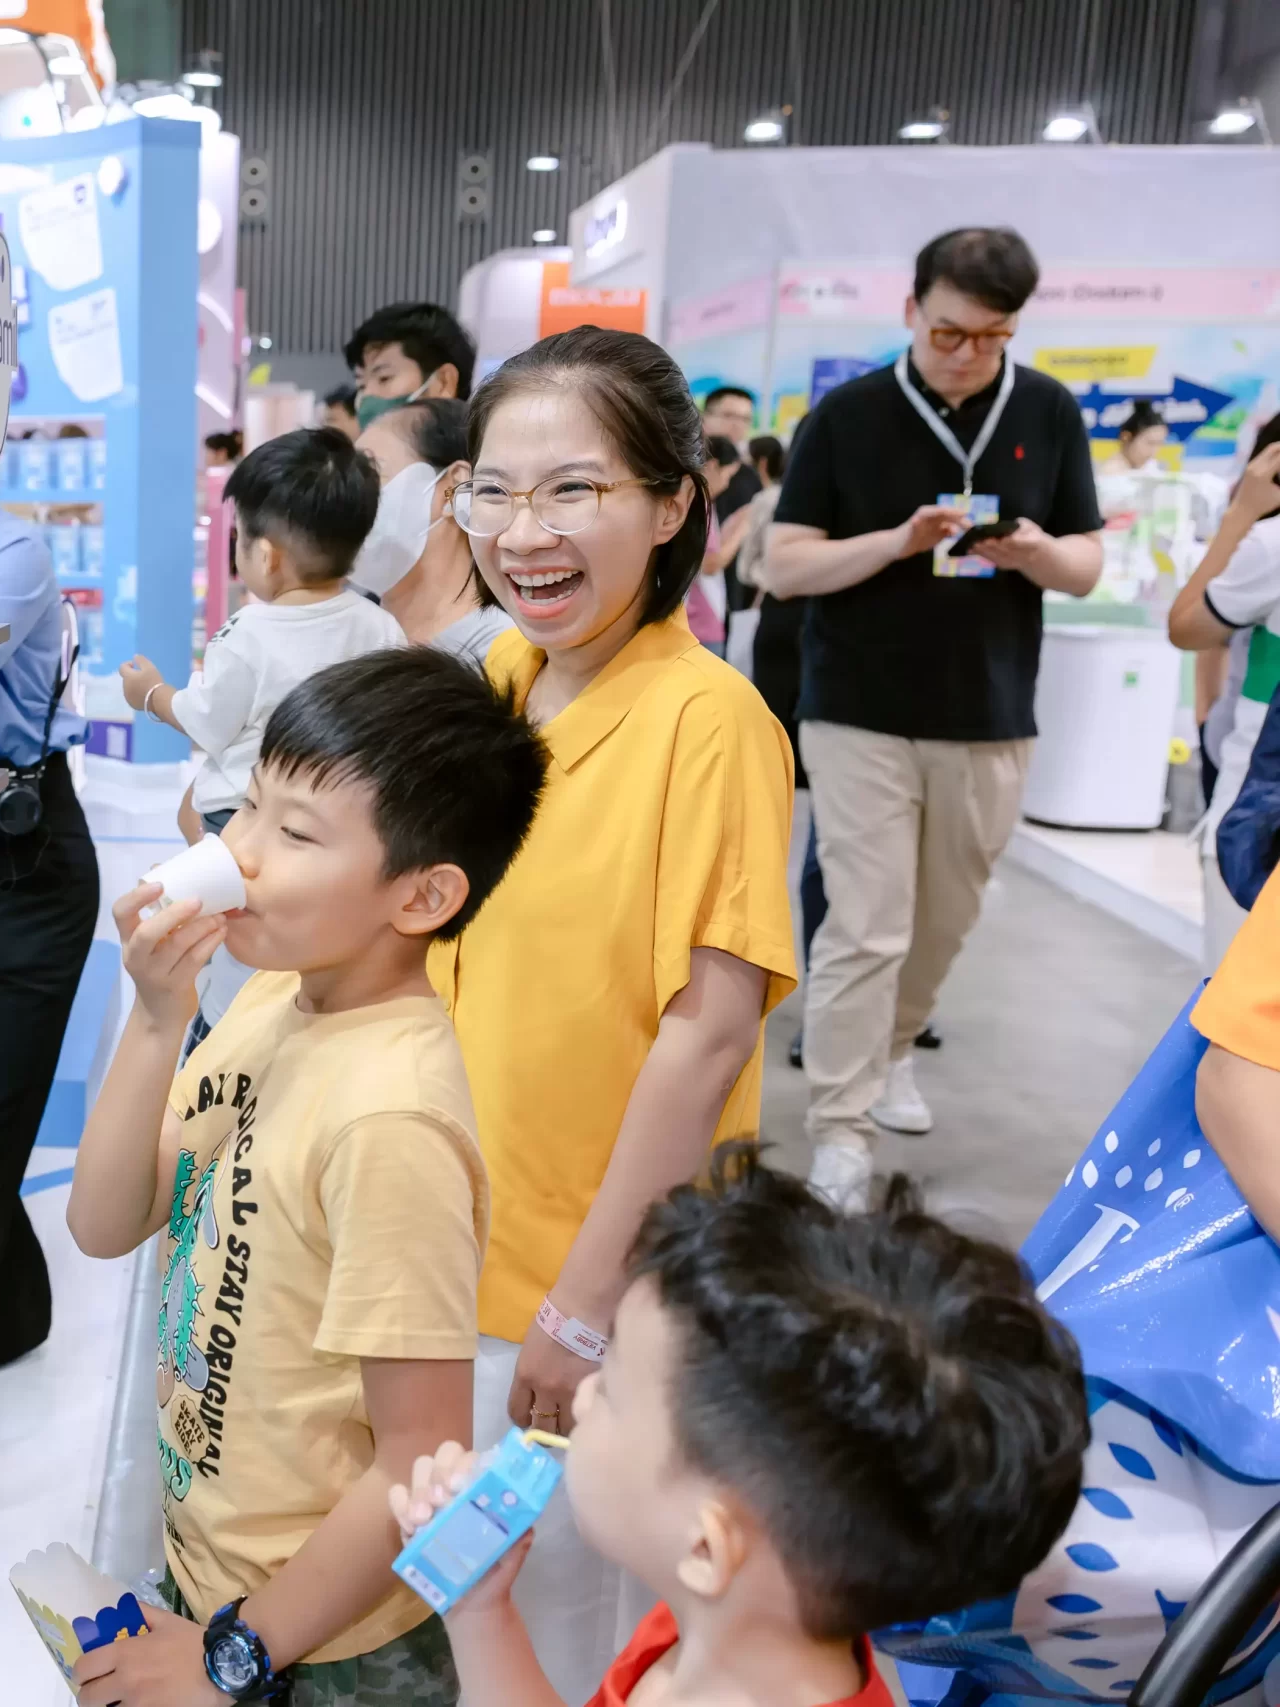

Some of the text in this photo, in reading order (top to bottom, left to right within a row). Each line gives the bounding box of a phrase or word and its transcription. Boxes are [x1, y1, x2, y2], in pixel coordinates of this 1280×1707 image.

[215, 1234, 251, 1326] STAY
[180, 1400, 205, 1443] SKATE
[197, 1324, 236, 1479] ORIGINAL
